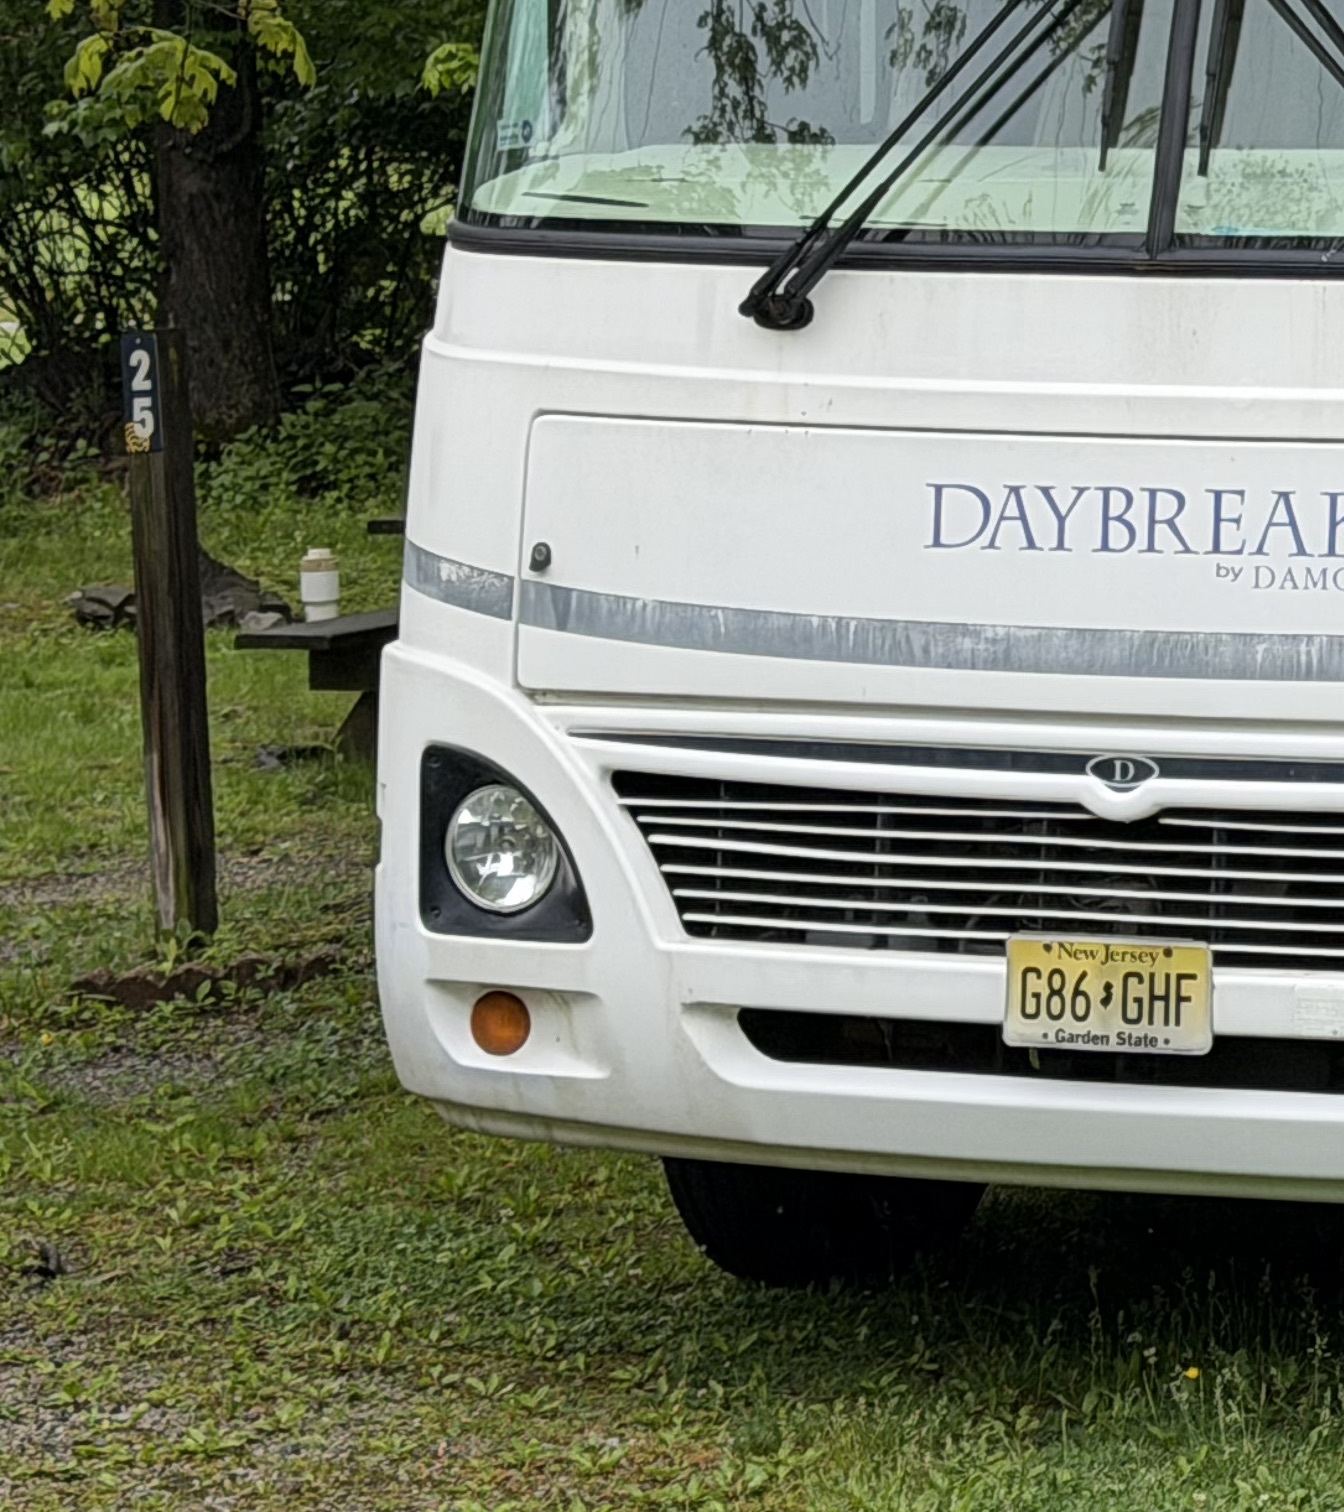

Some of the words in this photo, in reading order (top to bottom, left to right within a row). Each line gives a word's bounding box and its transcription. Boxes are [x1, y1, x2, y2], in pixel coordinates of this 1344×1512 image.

[129, 349, 154, 439] 25
[1215, 562, 1244, 582] by
[1112, 759, 1135, 781] D
[1057, 942, 1098, 961] New
[1100, 943, 1159, 966] Jersey
[1020, 966, 1092, 1023] G86
[1121, 971, 1198, 1027] GHF
[1054, 1028, 1110, 1046] Garden
[1115, 1031, 1159, 1048] State
